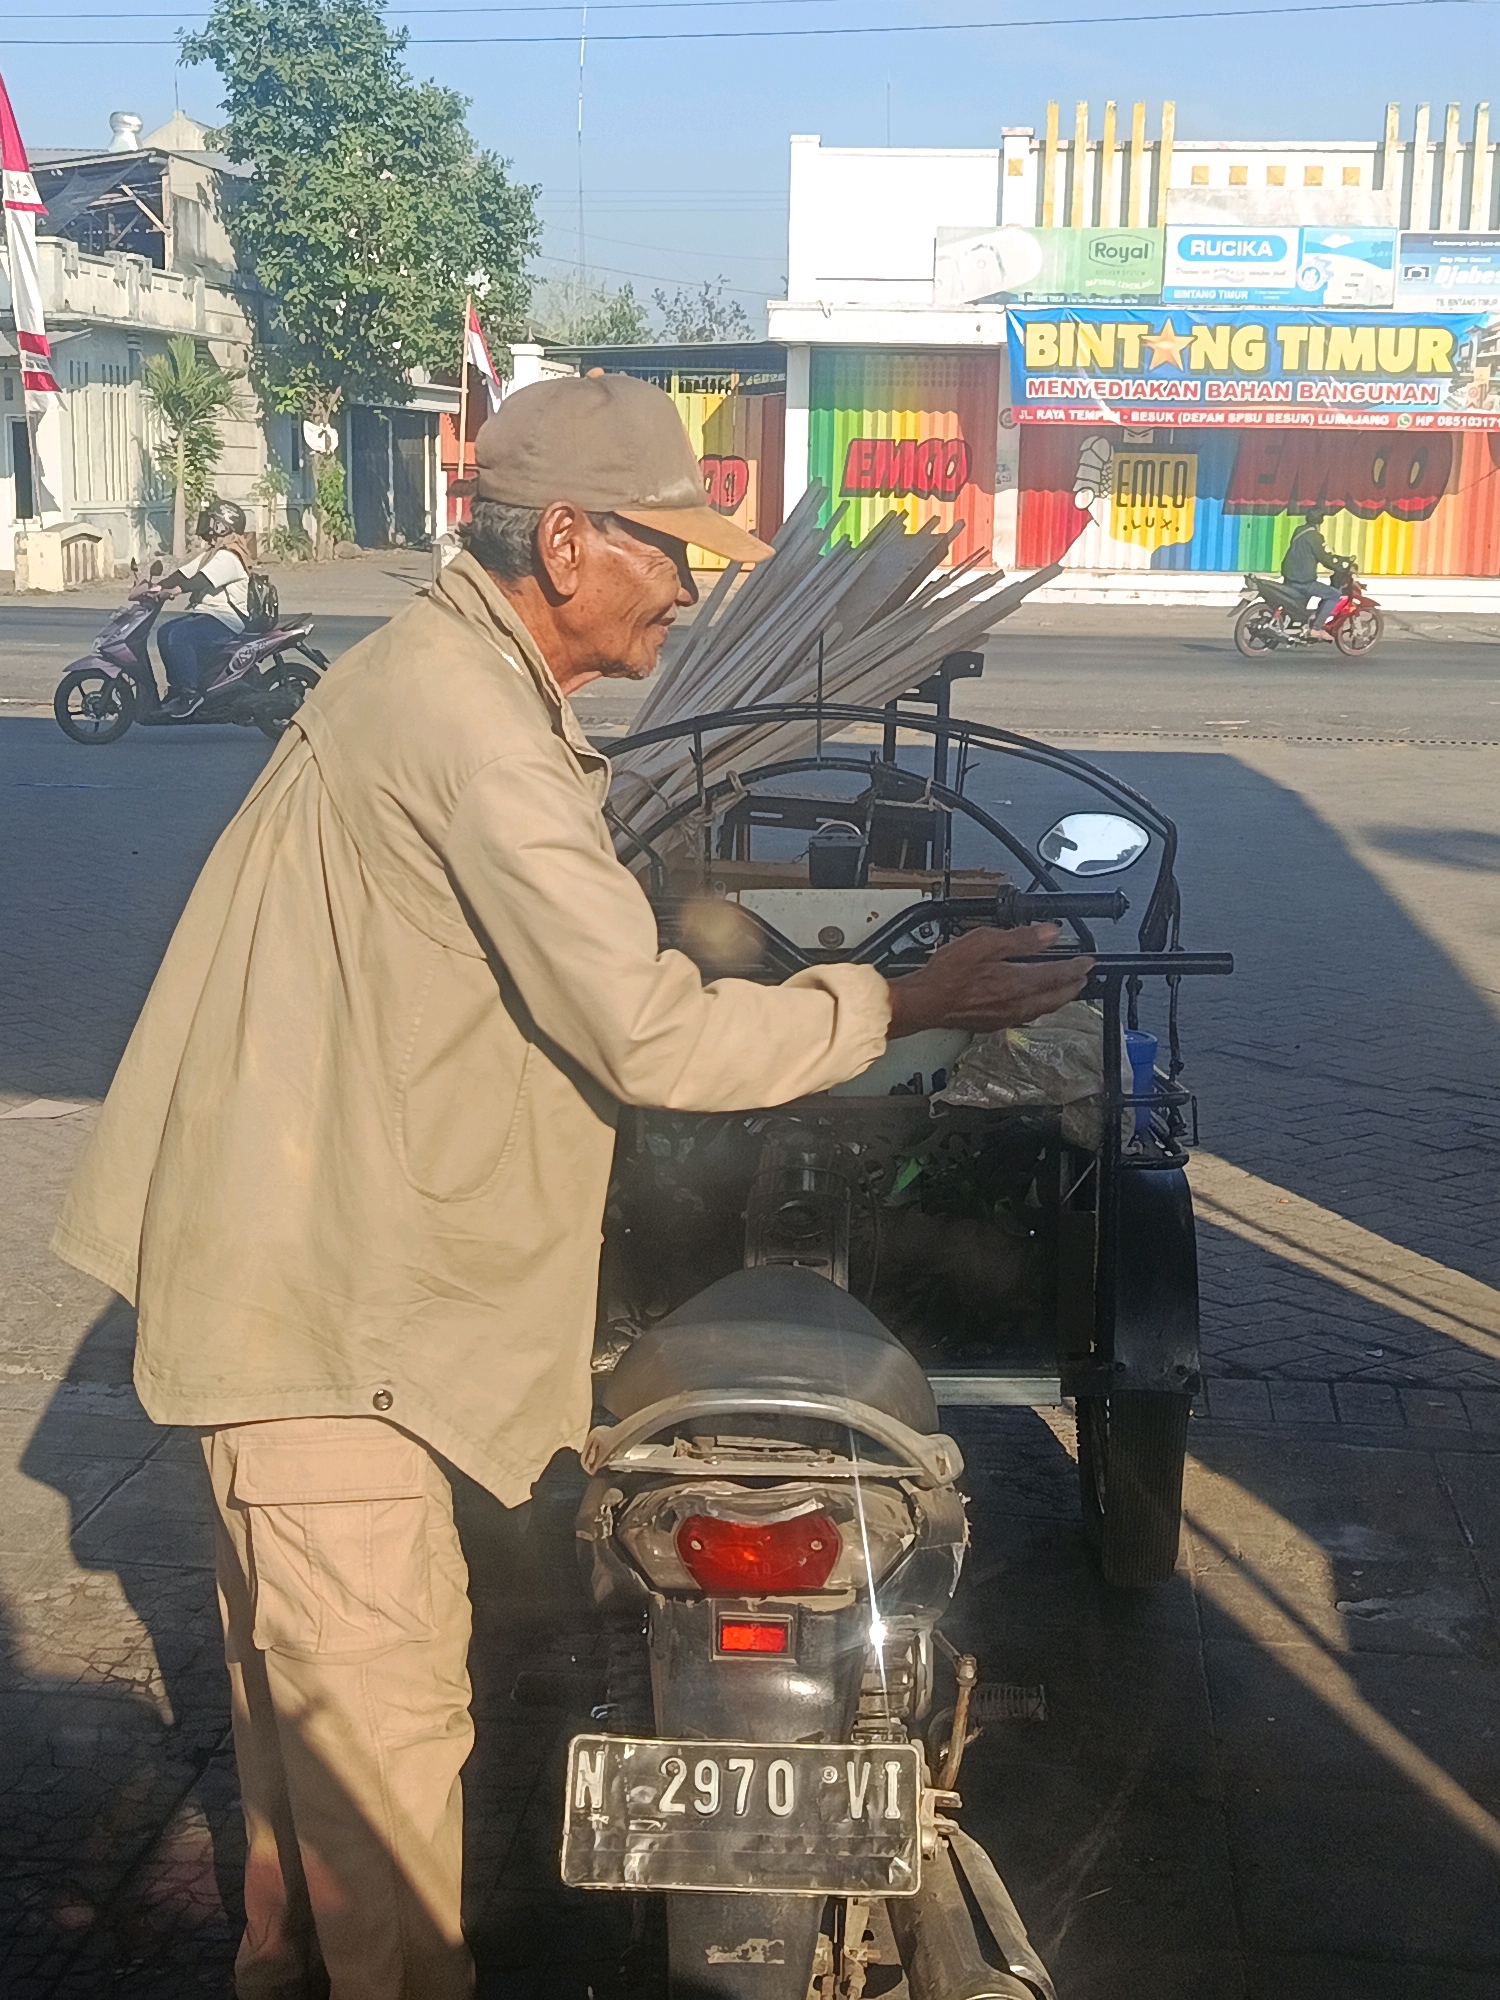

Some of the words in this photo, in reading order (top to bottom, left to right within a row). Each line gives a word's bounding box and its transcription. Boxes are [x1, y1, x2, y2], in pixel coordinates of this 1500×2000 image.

[1095, 242, 1149, 263] Royal
[1190, 239, 1273, 257] RUCIKA
[1173, 290, 1216, 299] BINTANG
[1218, 290, 1249, 300] TIMUR
[1276, 327, 1455, 375] TIMUR
[1027, 379, 1200, 400] MENYEDIAKAN
[1207, 380, 1291, 401] BAHAN
[1298, 382, 1438, 403] BANGUNAN
[1036, 410, 1066, 421] RAYA
[1131, 411, 1174, 423] BESUK
[1178, 412, 1224, 424] (DEPAN
[1266, 413, 1315, 427] BESUK)
[1317, 413, 1390, 426] LUMAJANG
[1415, 415, 1435, 427] HP
[840, 438, 971, 502] EMCO
[1116, 459, 1188, 508] EMCO
[1223, 430, 1453, 520] EMCO
[574, 1750, 606, 1810] N
[659, 1757, 794, 1817] 2970
[847, 1761, 901, 1820] VI
